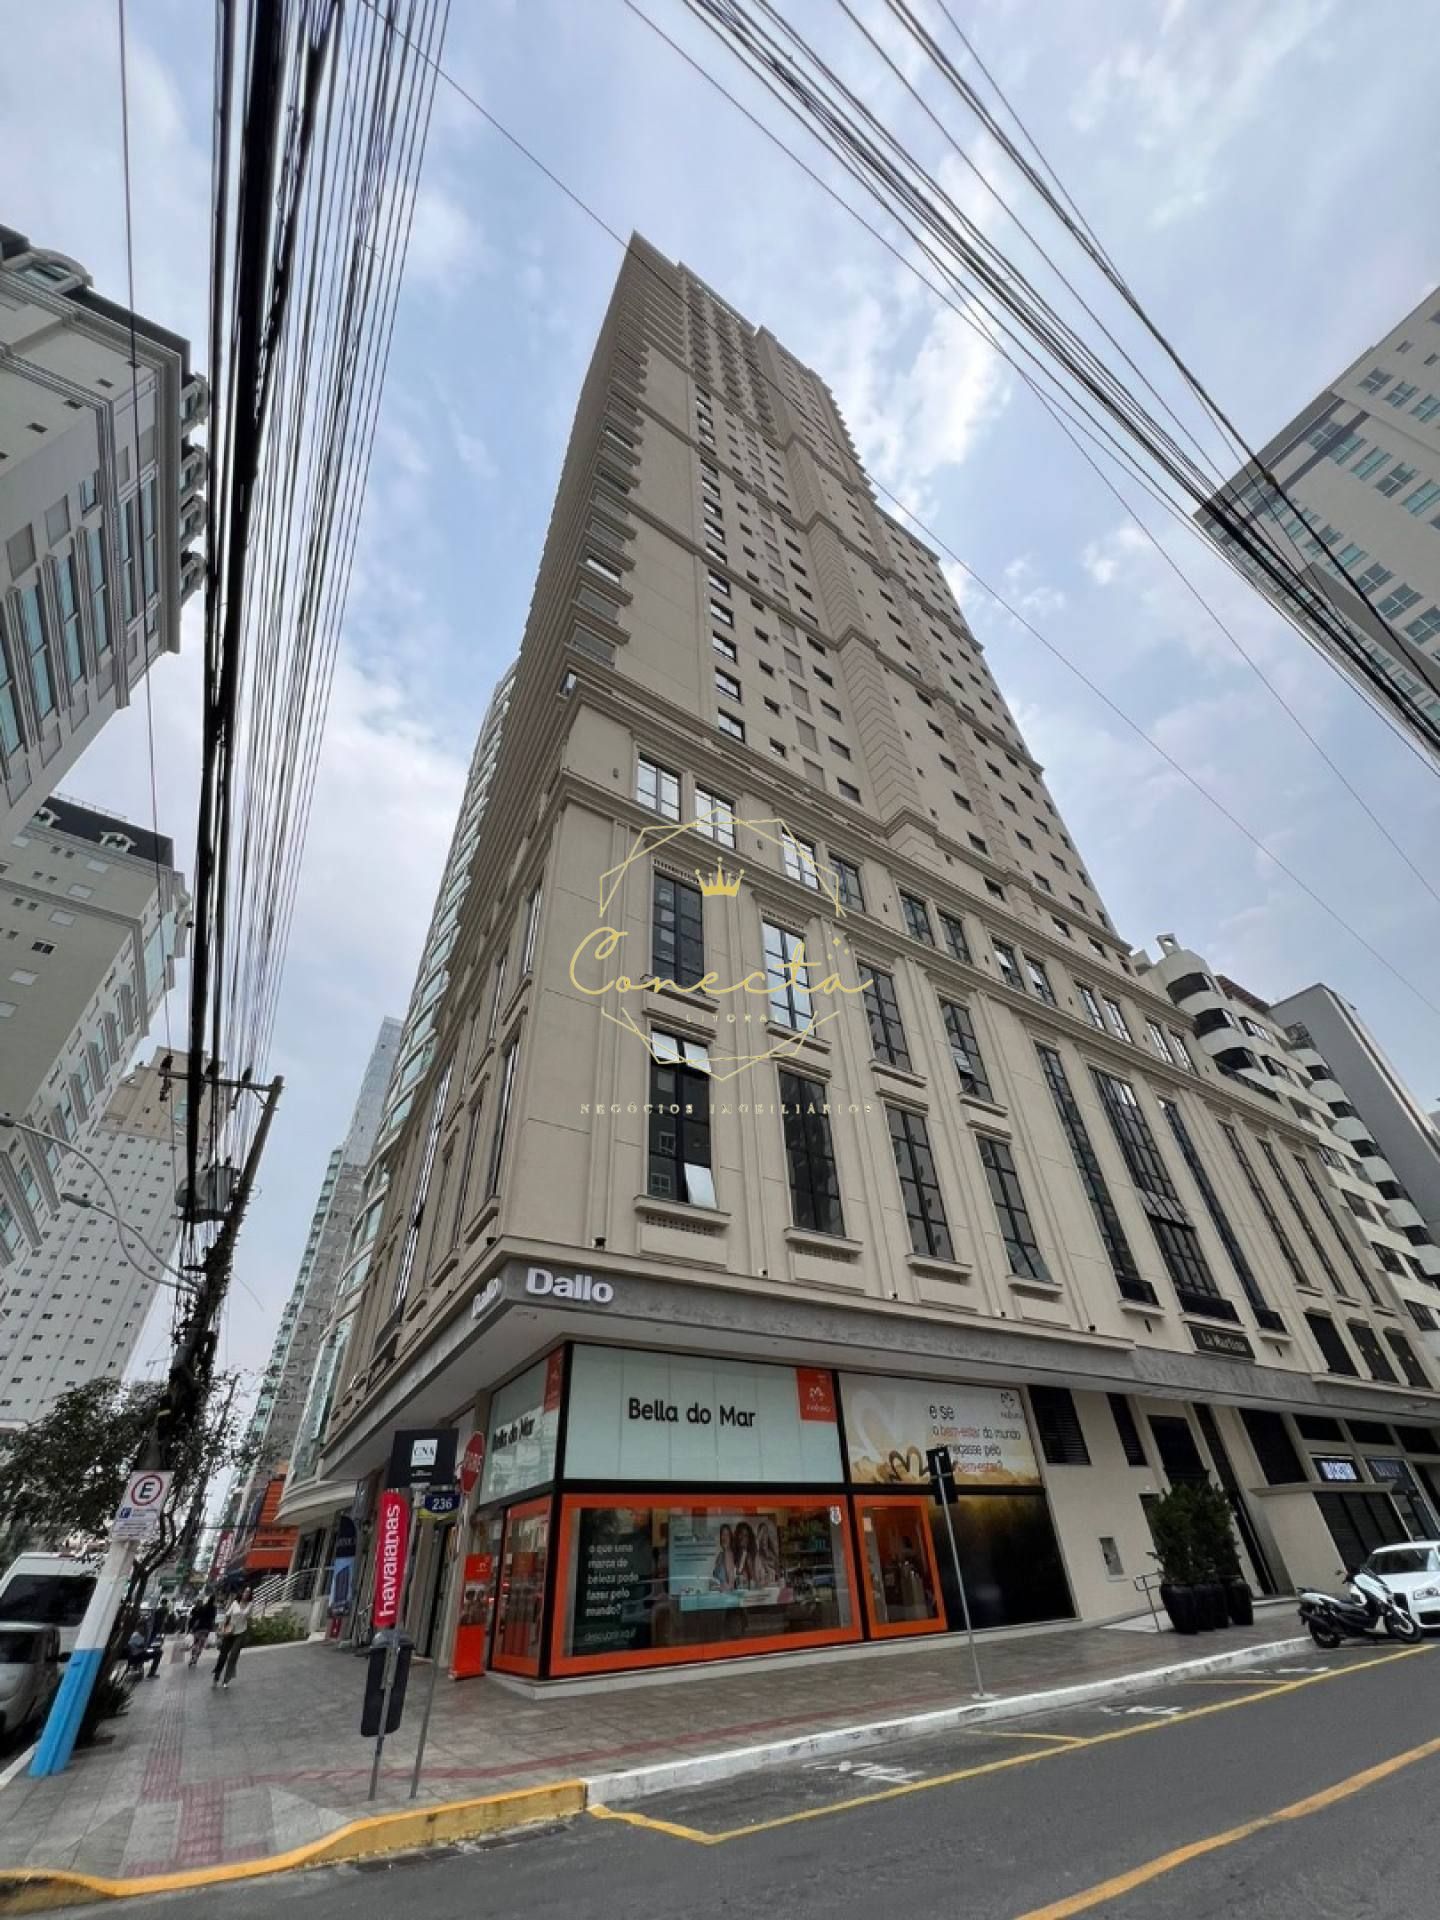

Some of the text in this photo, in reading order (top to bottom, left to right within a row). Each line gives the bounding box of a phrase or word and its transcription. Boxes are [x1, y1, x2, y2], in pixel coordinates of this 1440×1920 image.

[526, 1266, 614, 1304] Dallo
[628, 1396, 756, 1427] Bella do Mar
[139, 1482, 155, 1499] E
[431, 1498, 453, 1511] 236
[379, 1504, 401, 1617] havaianas
